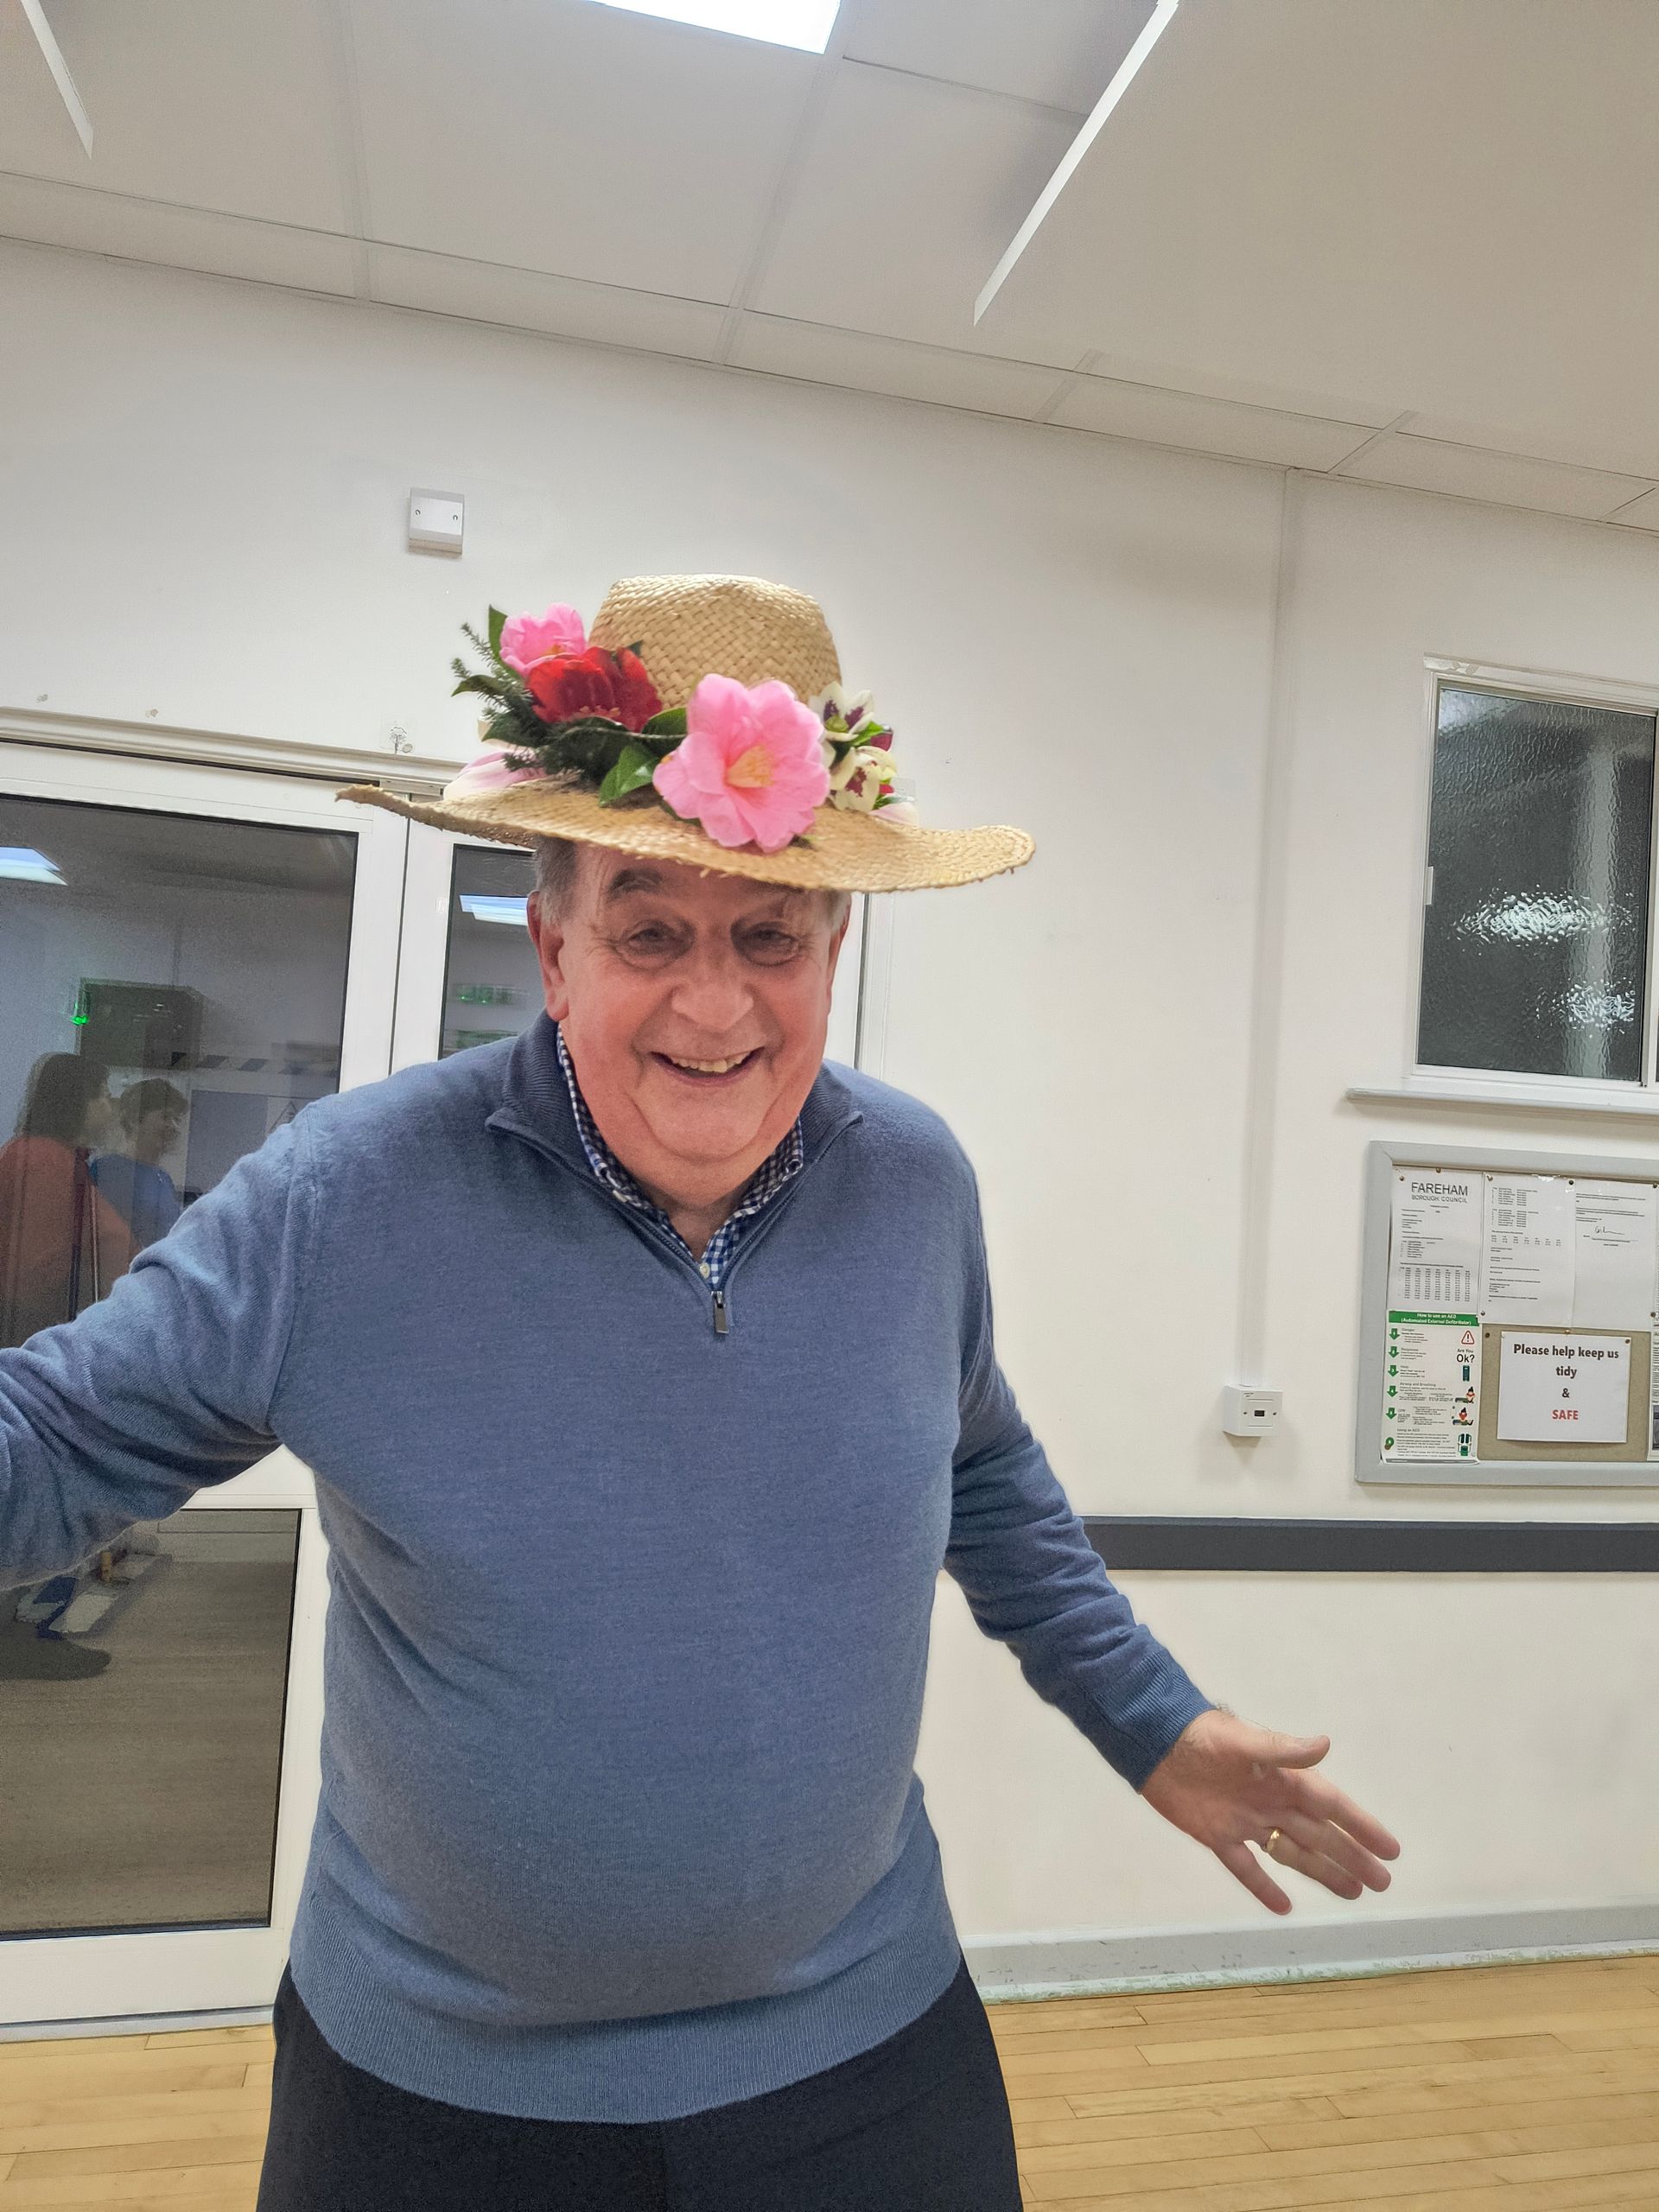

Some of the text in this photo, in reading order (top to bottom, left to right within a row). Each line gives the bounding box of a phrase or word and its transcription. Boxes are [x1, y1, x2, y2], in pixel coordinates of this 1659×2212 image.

[1411, 1182, 1468, 1196] FAREHAM
[1513, 1344, 1549, 1356] Please
[1552, 1345, 1574, 1359] help
[1578, 1346, 1605, 1360] keep
[1457, 1354, 1475, 1363] Ok?
[1555, 1366, 1577, 1379] tidy
[1561, 1388, 1570, 1398] &
[1552, 1409, 1579, 1420] SAFE
